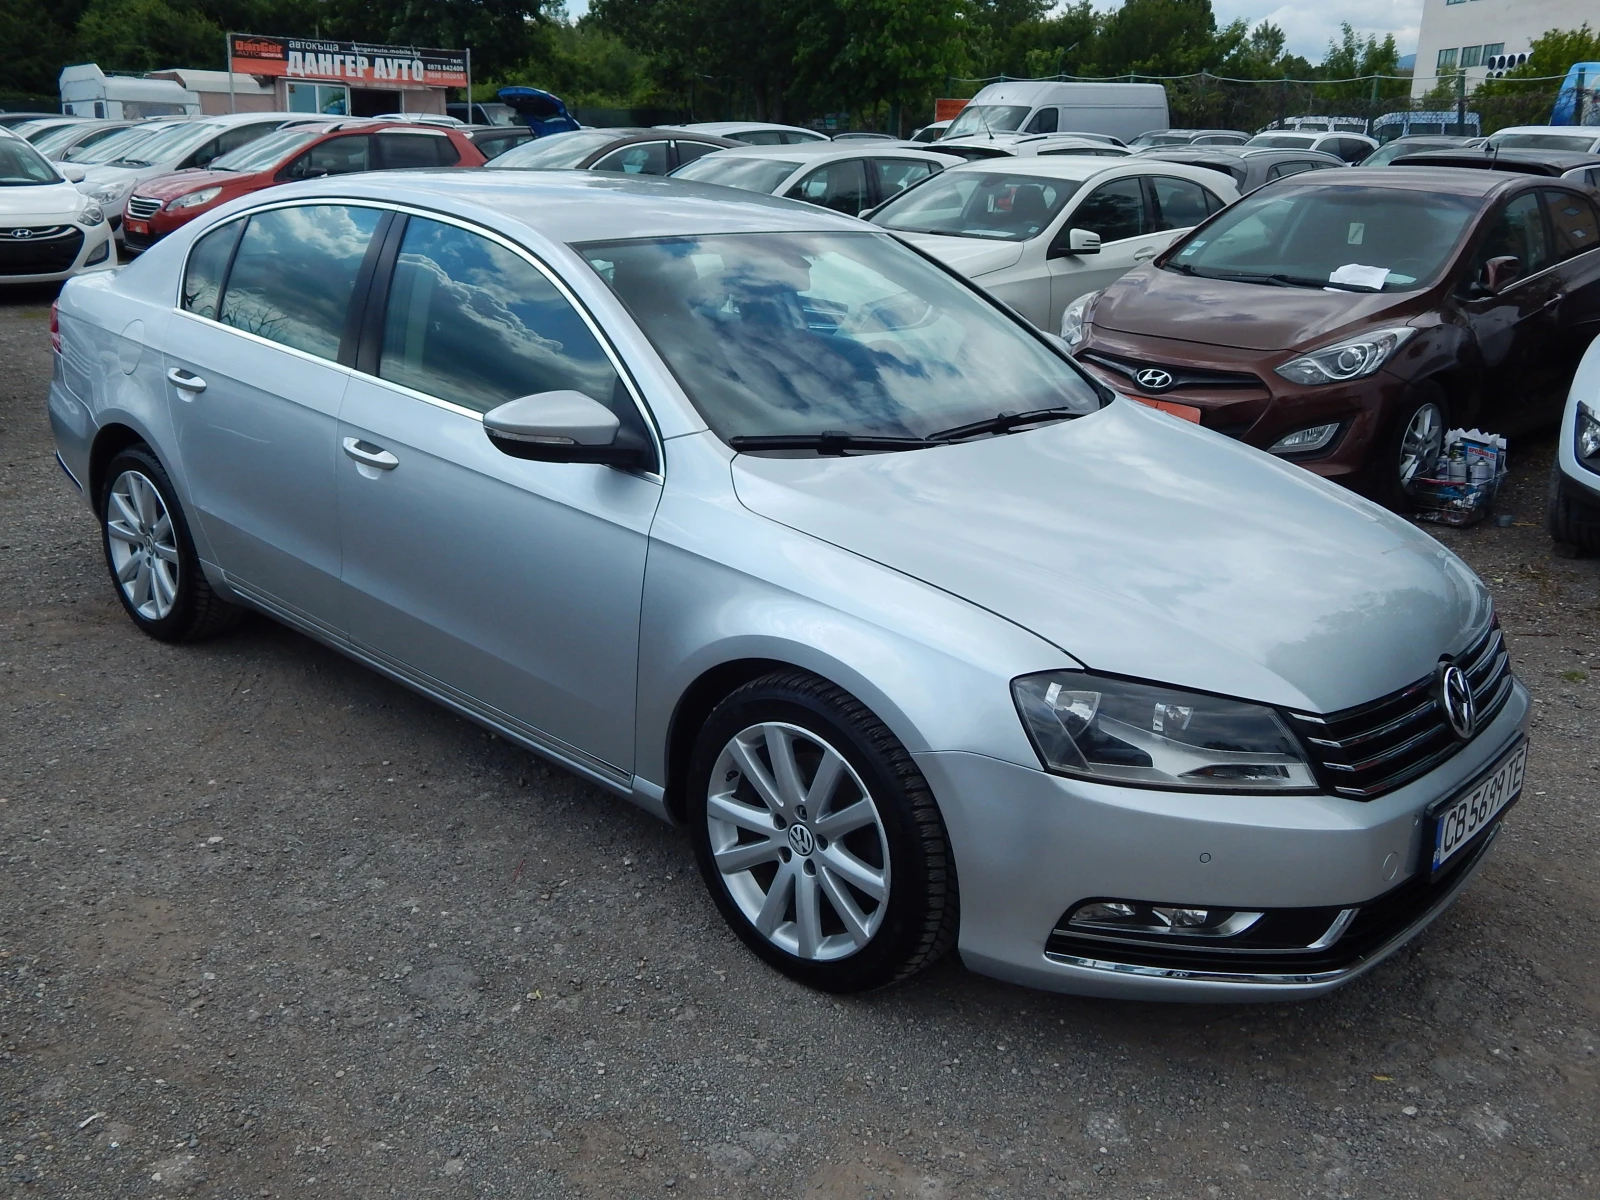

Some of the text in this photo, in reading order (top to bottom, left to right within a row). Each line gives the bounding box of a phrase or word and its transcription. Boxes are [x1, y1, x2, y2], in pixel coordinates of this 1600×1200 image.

[235, 40, 283, 53] DanGer
[288, 40, 339, 52] автокъща
[286, 50, 369, 78] ДАНГЕР
[1468, 771, 1505, 832] 5699
